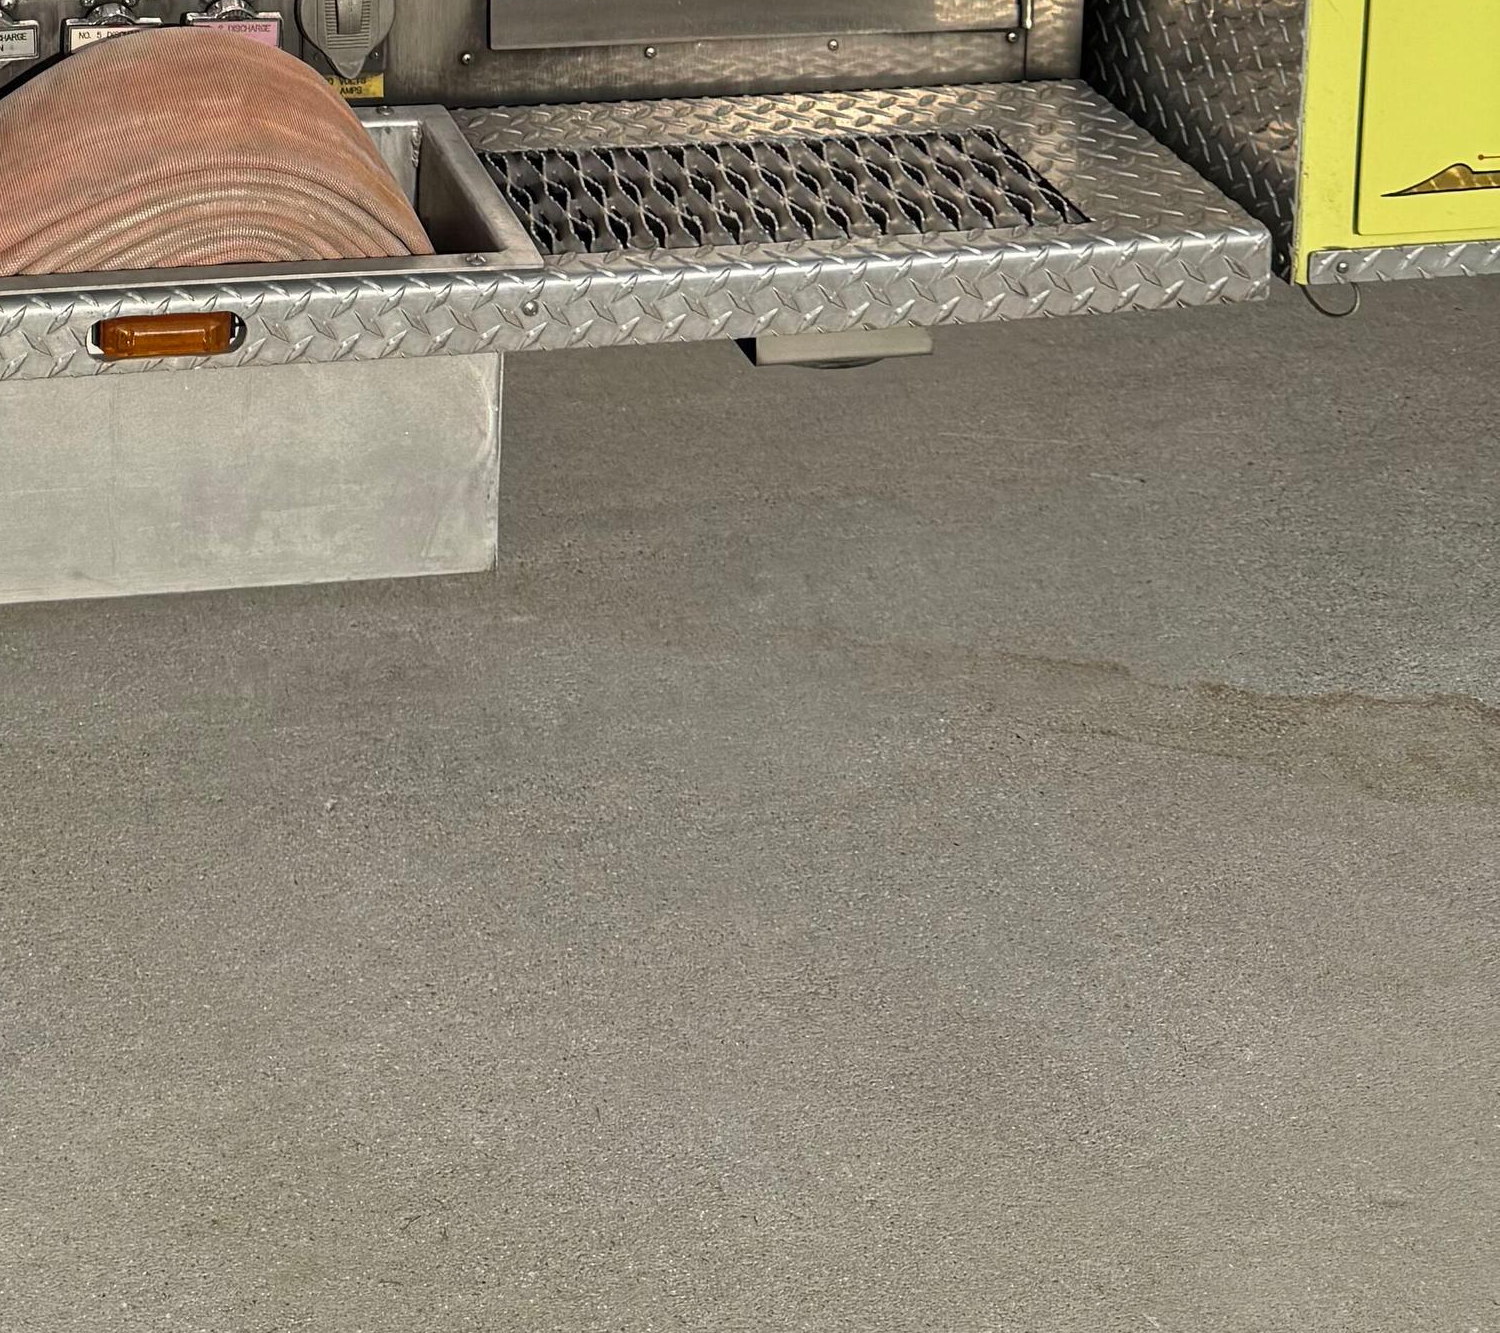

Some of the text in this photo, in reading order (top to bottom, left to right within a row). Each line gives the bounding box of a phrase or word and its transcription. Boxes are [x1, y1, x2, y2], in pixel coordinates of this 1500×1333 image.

[228, 24, 271, 32] DISCHARGE
[78, 31, 91, 39] NO.
[340, 86, 362, 94] AMPS
